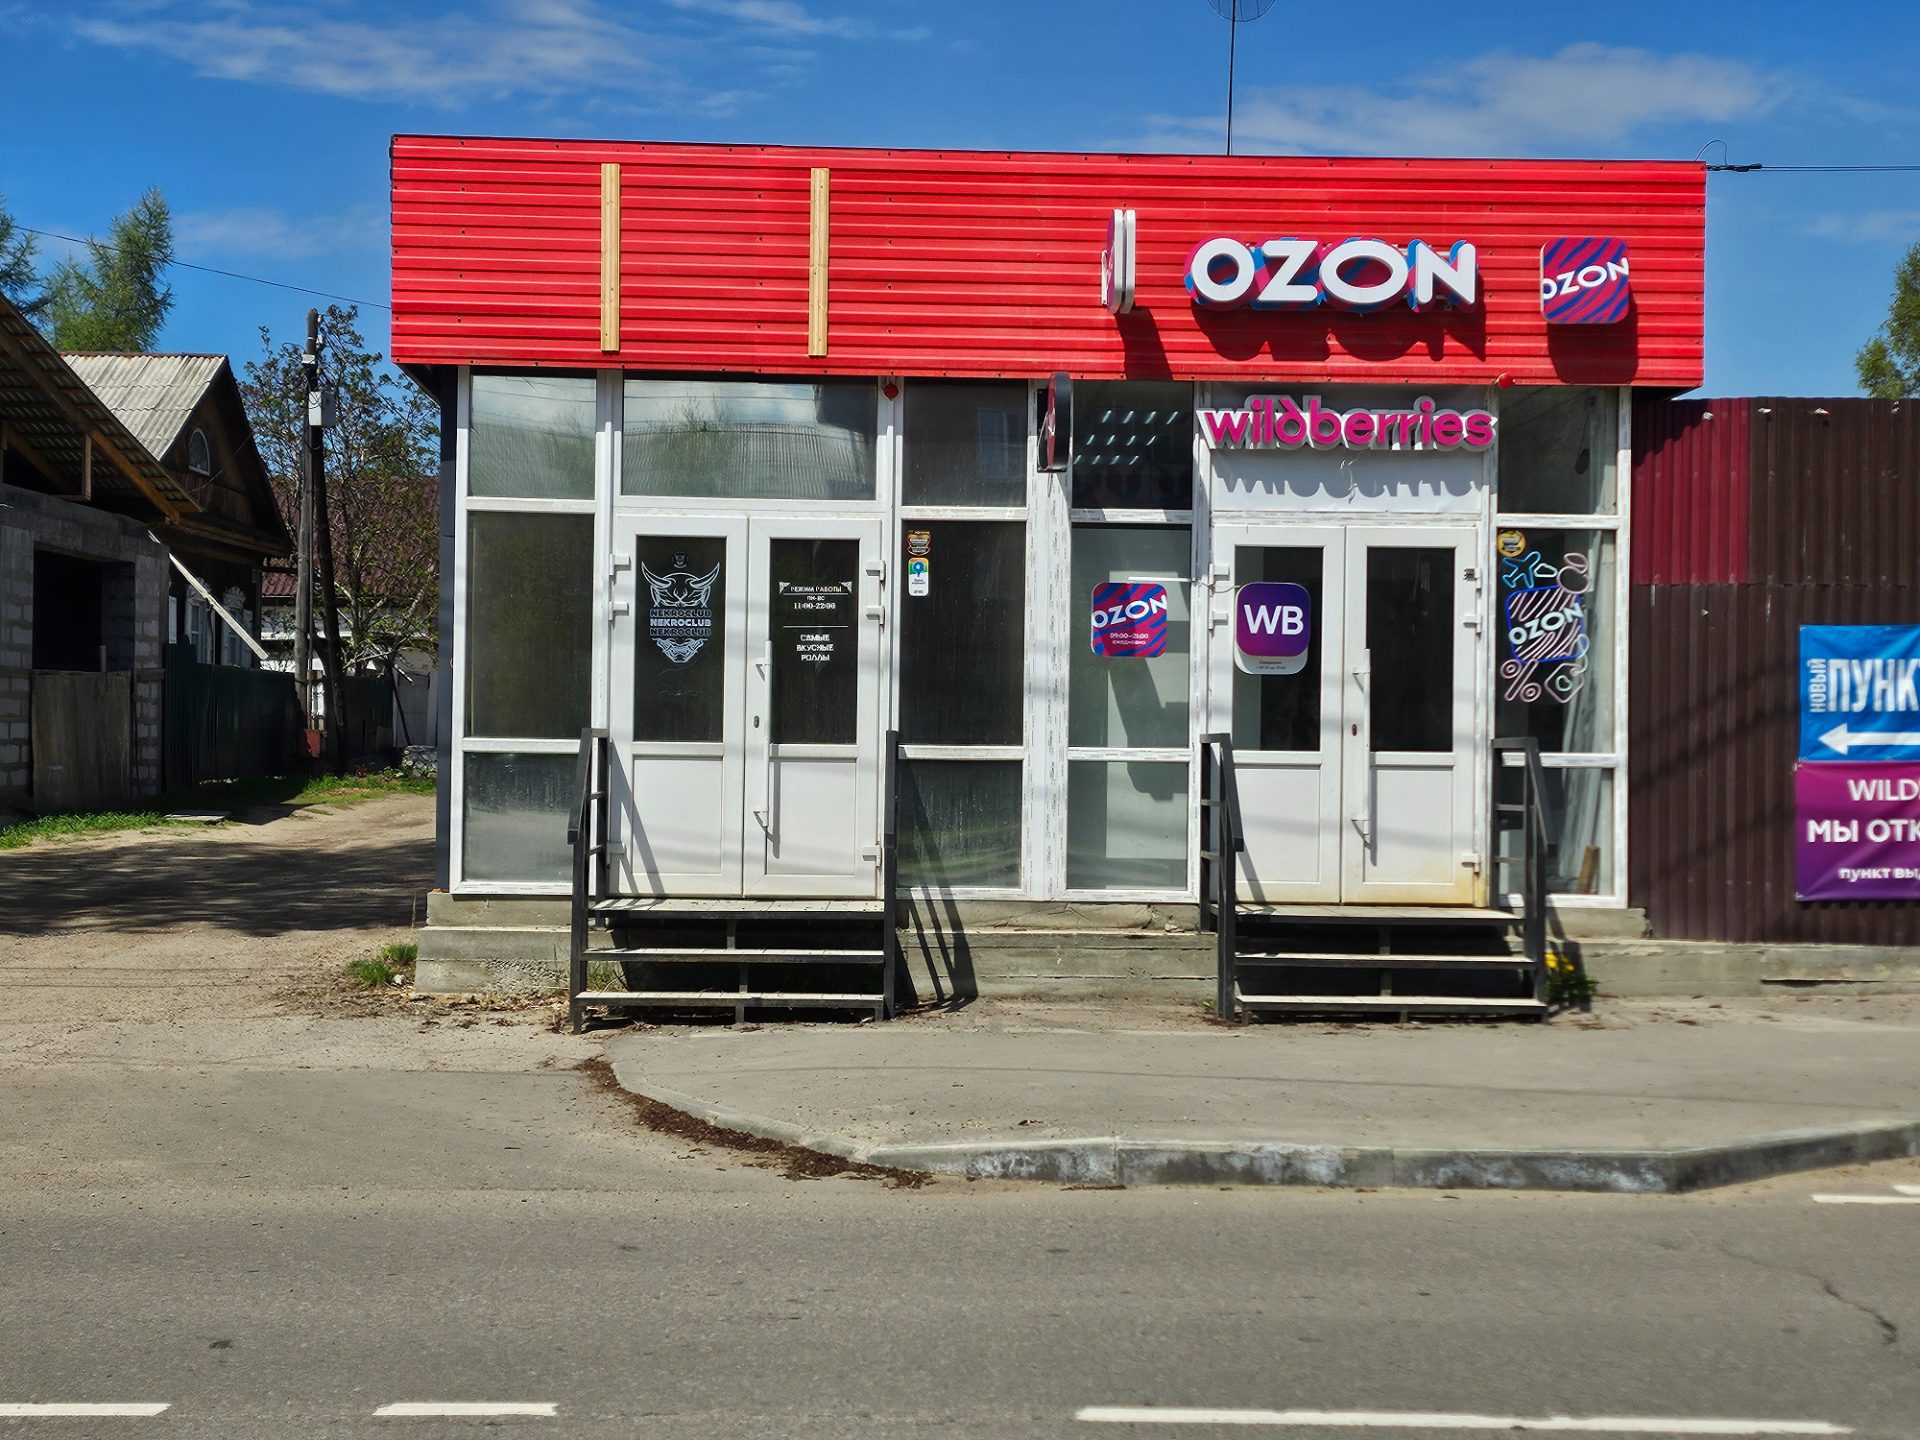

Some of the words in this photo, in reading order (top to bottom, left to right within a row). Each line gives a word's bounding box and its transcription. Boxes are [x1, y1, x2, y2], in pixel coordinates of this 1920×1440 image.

[1191, 237, 1476, 305] OZON
[1543, 257, 1630, 300] OZON
[1203, 397, 1495, 446] wildberries
[650, 608, 712, 618] NEKROCLUB
[650, 618, 712, 627] NEKROCLUB
[1091, 594, 1168, 628] OZON
[1243, 604, 1304, 636] WB
[1508, 603, 1584, 645] OZON
[650, 627, 712, 637] NEKROCLUB
[796, 644, 834, 652] ВКУСНЫЕ
[1807, 658, 1827, 713] НОВЫЙ
[1828, 658, 1920, 712] ПУНК
[1848, 779, 1920, 801] WILD
[1807, 819, 1859, 842] МЫ
[1838, 868, 1891, 882] пункт
